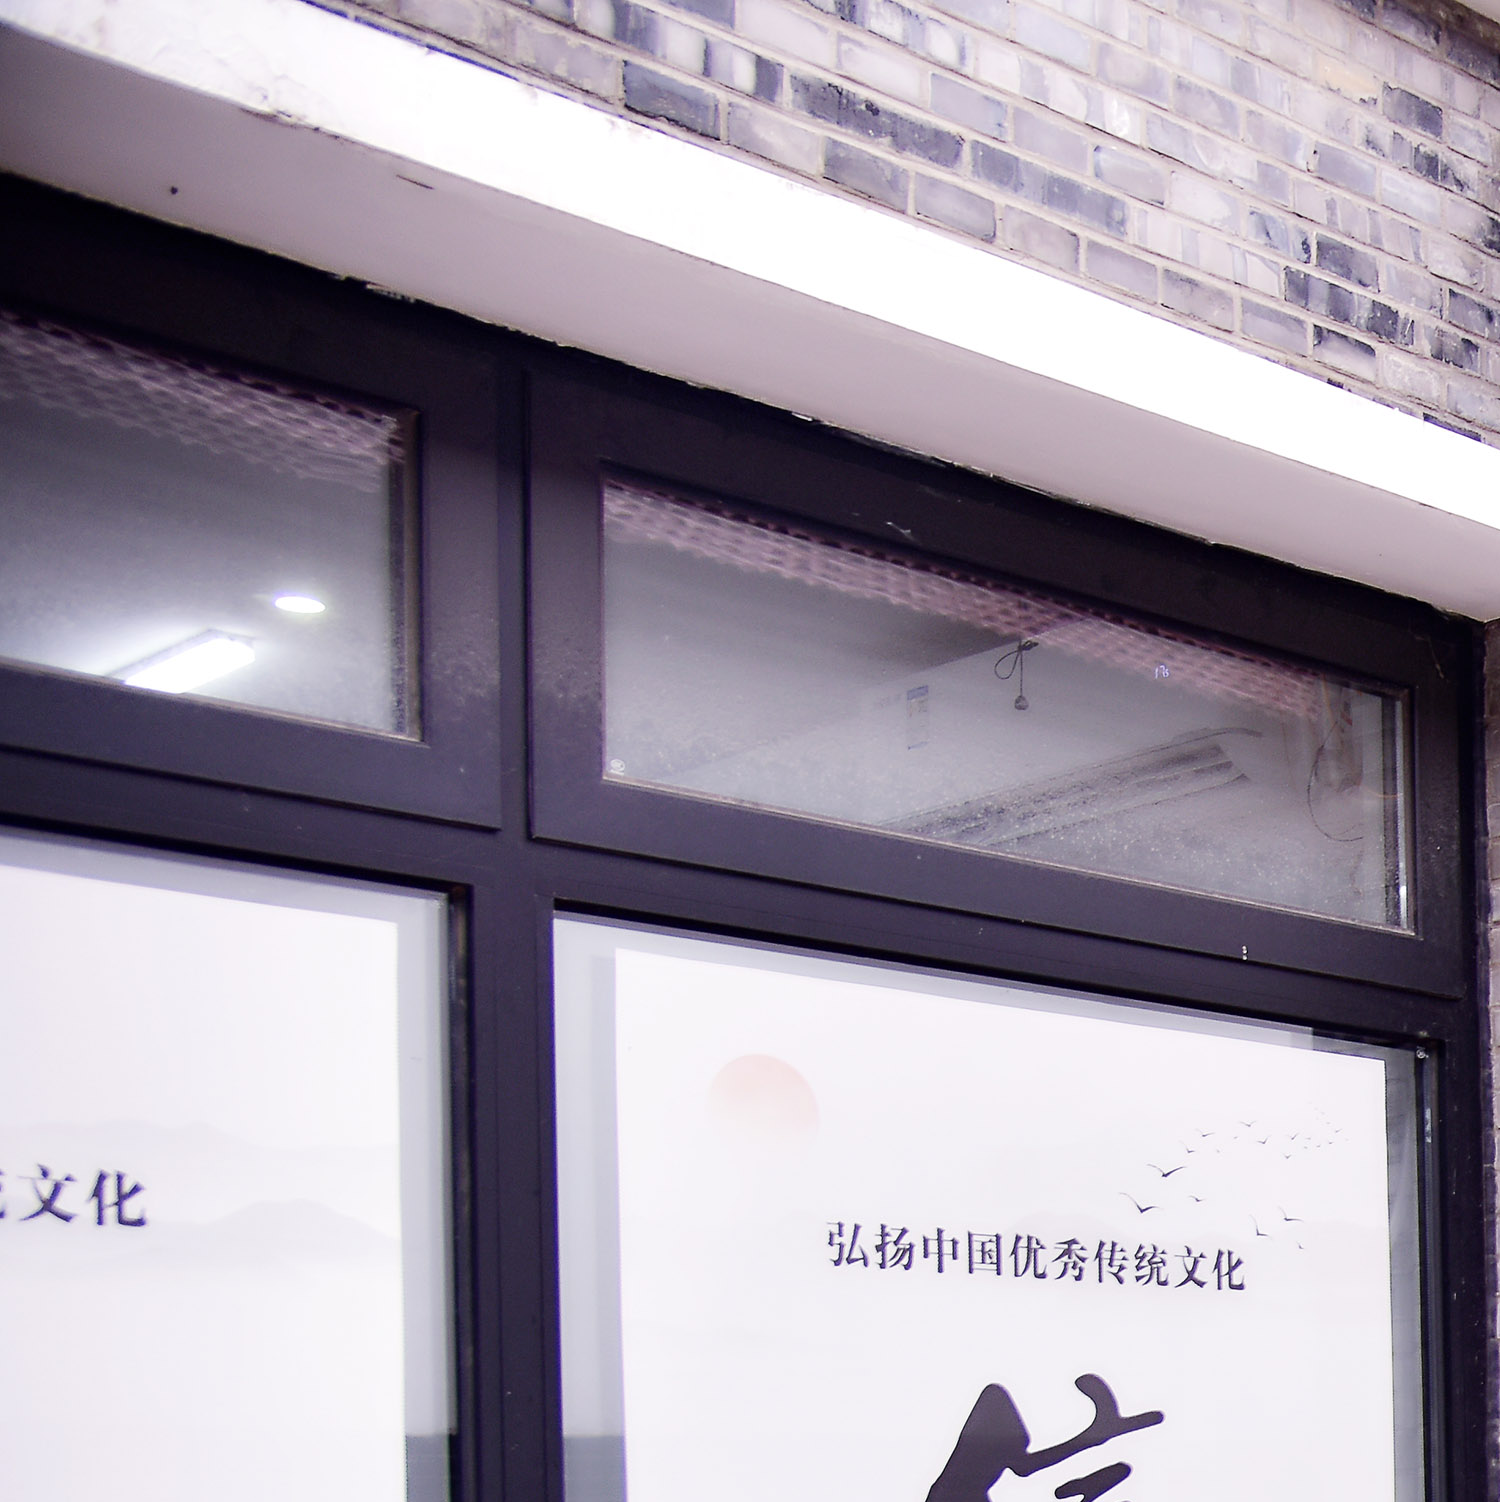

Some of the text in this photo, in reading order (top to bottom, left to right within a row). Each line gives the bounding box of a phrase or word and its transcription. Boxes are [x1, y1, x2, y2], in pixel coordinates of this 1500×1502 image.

[0, 1164, 147, 1227] 文化
[826, 1221, 1246, 1291] 弘扬中国优秀传统文化
